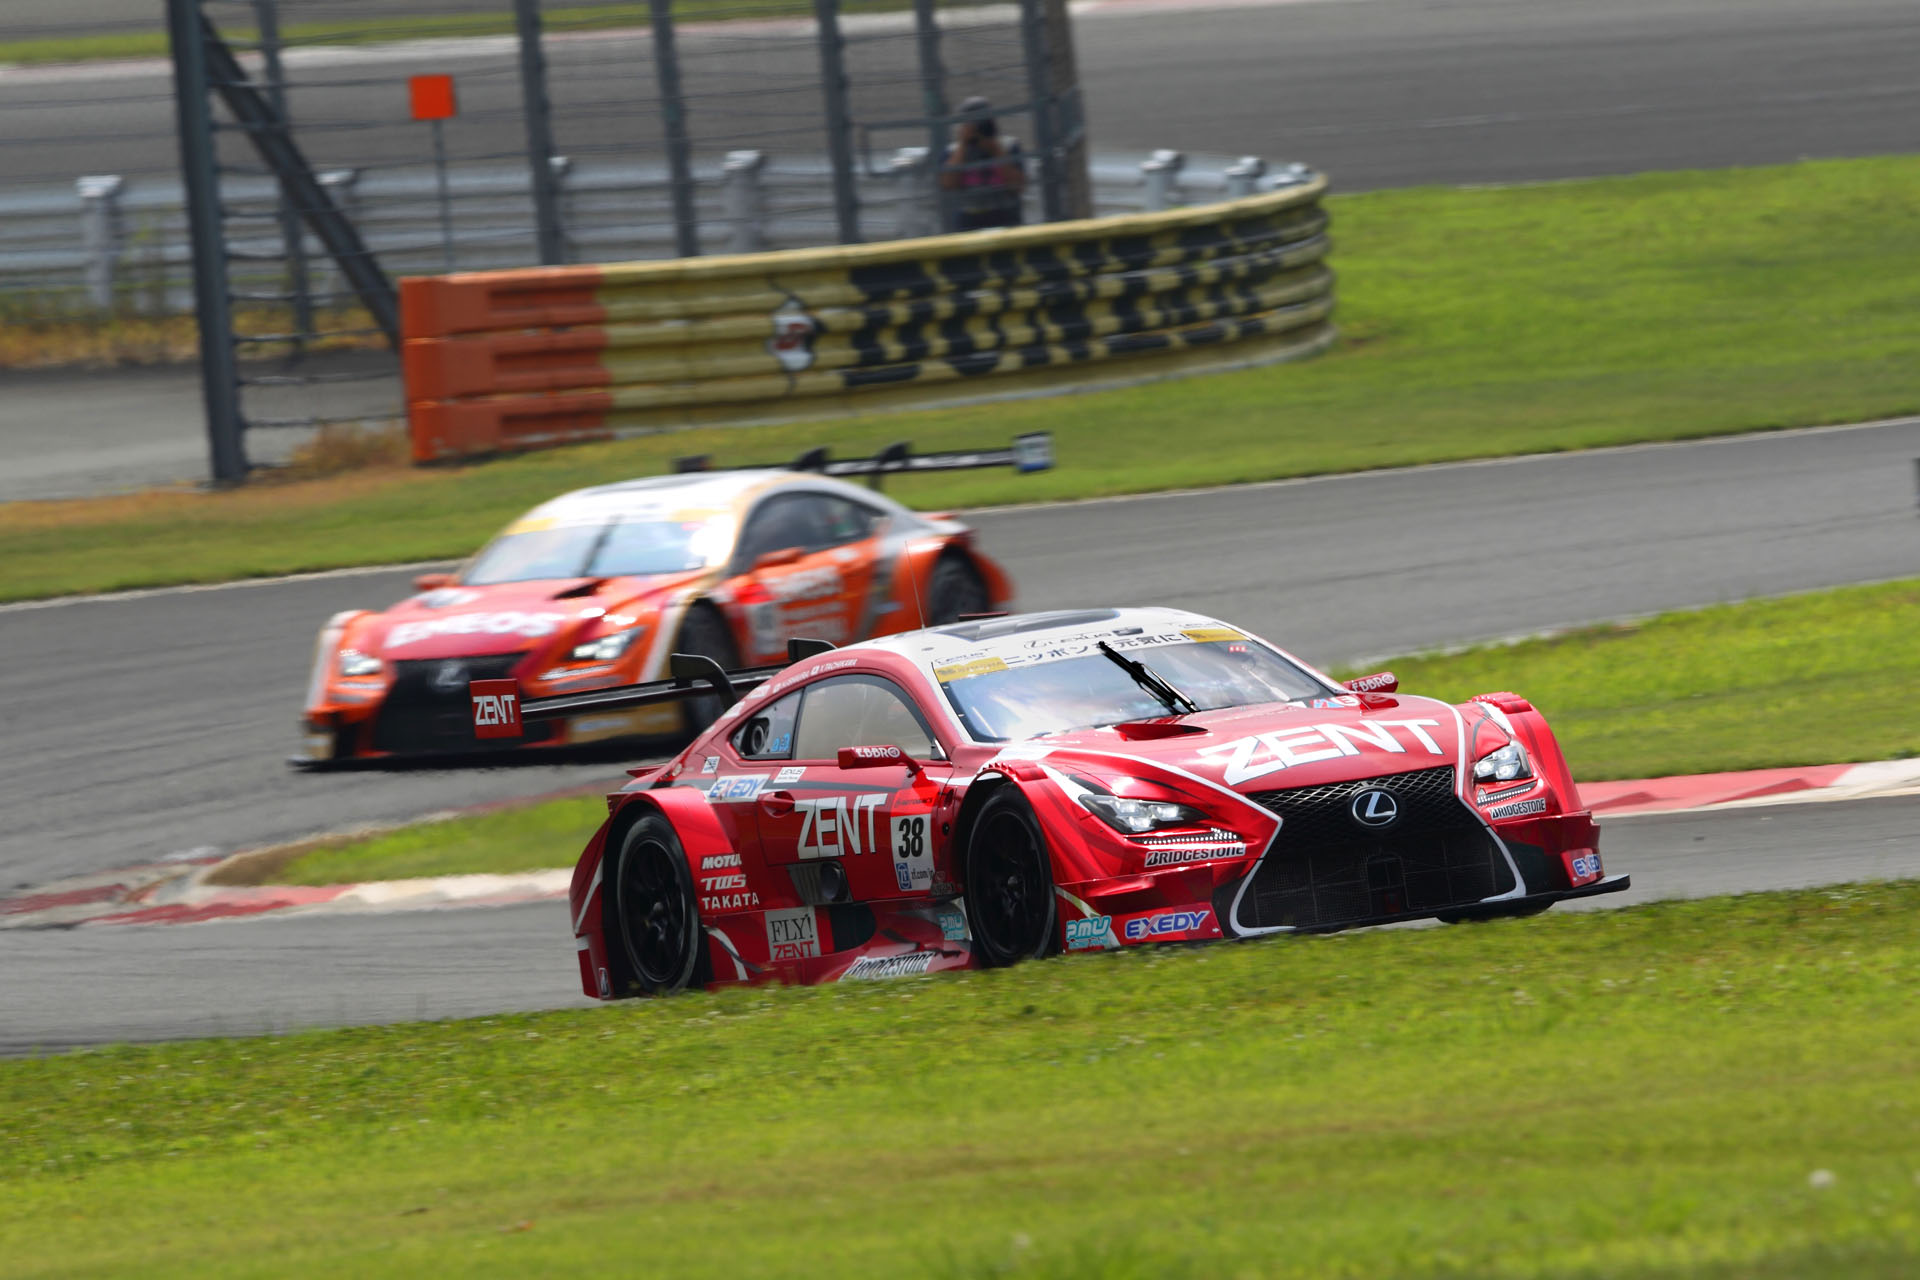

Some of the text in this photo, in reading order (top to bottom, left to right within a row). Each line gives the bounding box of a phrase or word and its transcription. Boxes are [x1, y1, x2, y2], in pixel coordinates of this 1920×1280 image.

[472, 694, 516, 726] ZENT
[855, 746, 900, 758] EBBRO
[1196, 719, 1444, 786] ZENT
[709, 777, 766, 799] EXEDY
[1492, 799, 1545, 818] BRIDGESTONE
[794, 793, 888, 860] ZENT
[898, 817, 924, 858] 38
[1146, 847, 1244, 866] BRIDGESTONE
[1573, 854, 1600, 877] EXED
[701, 874, 746, 891] TWS
[702, 892, 759, 910] TAKATA
[770, 914, 813, 943] FLY!
[1066, 916, 1111, 942] PMU
[1126, 911, 1210, 938] EXEDY
[773, 940, 814, 960] ZENT
